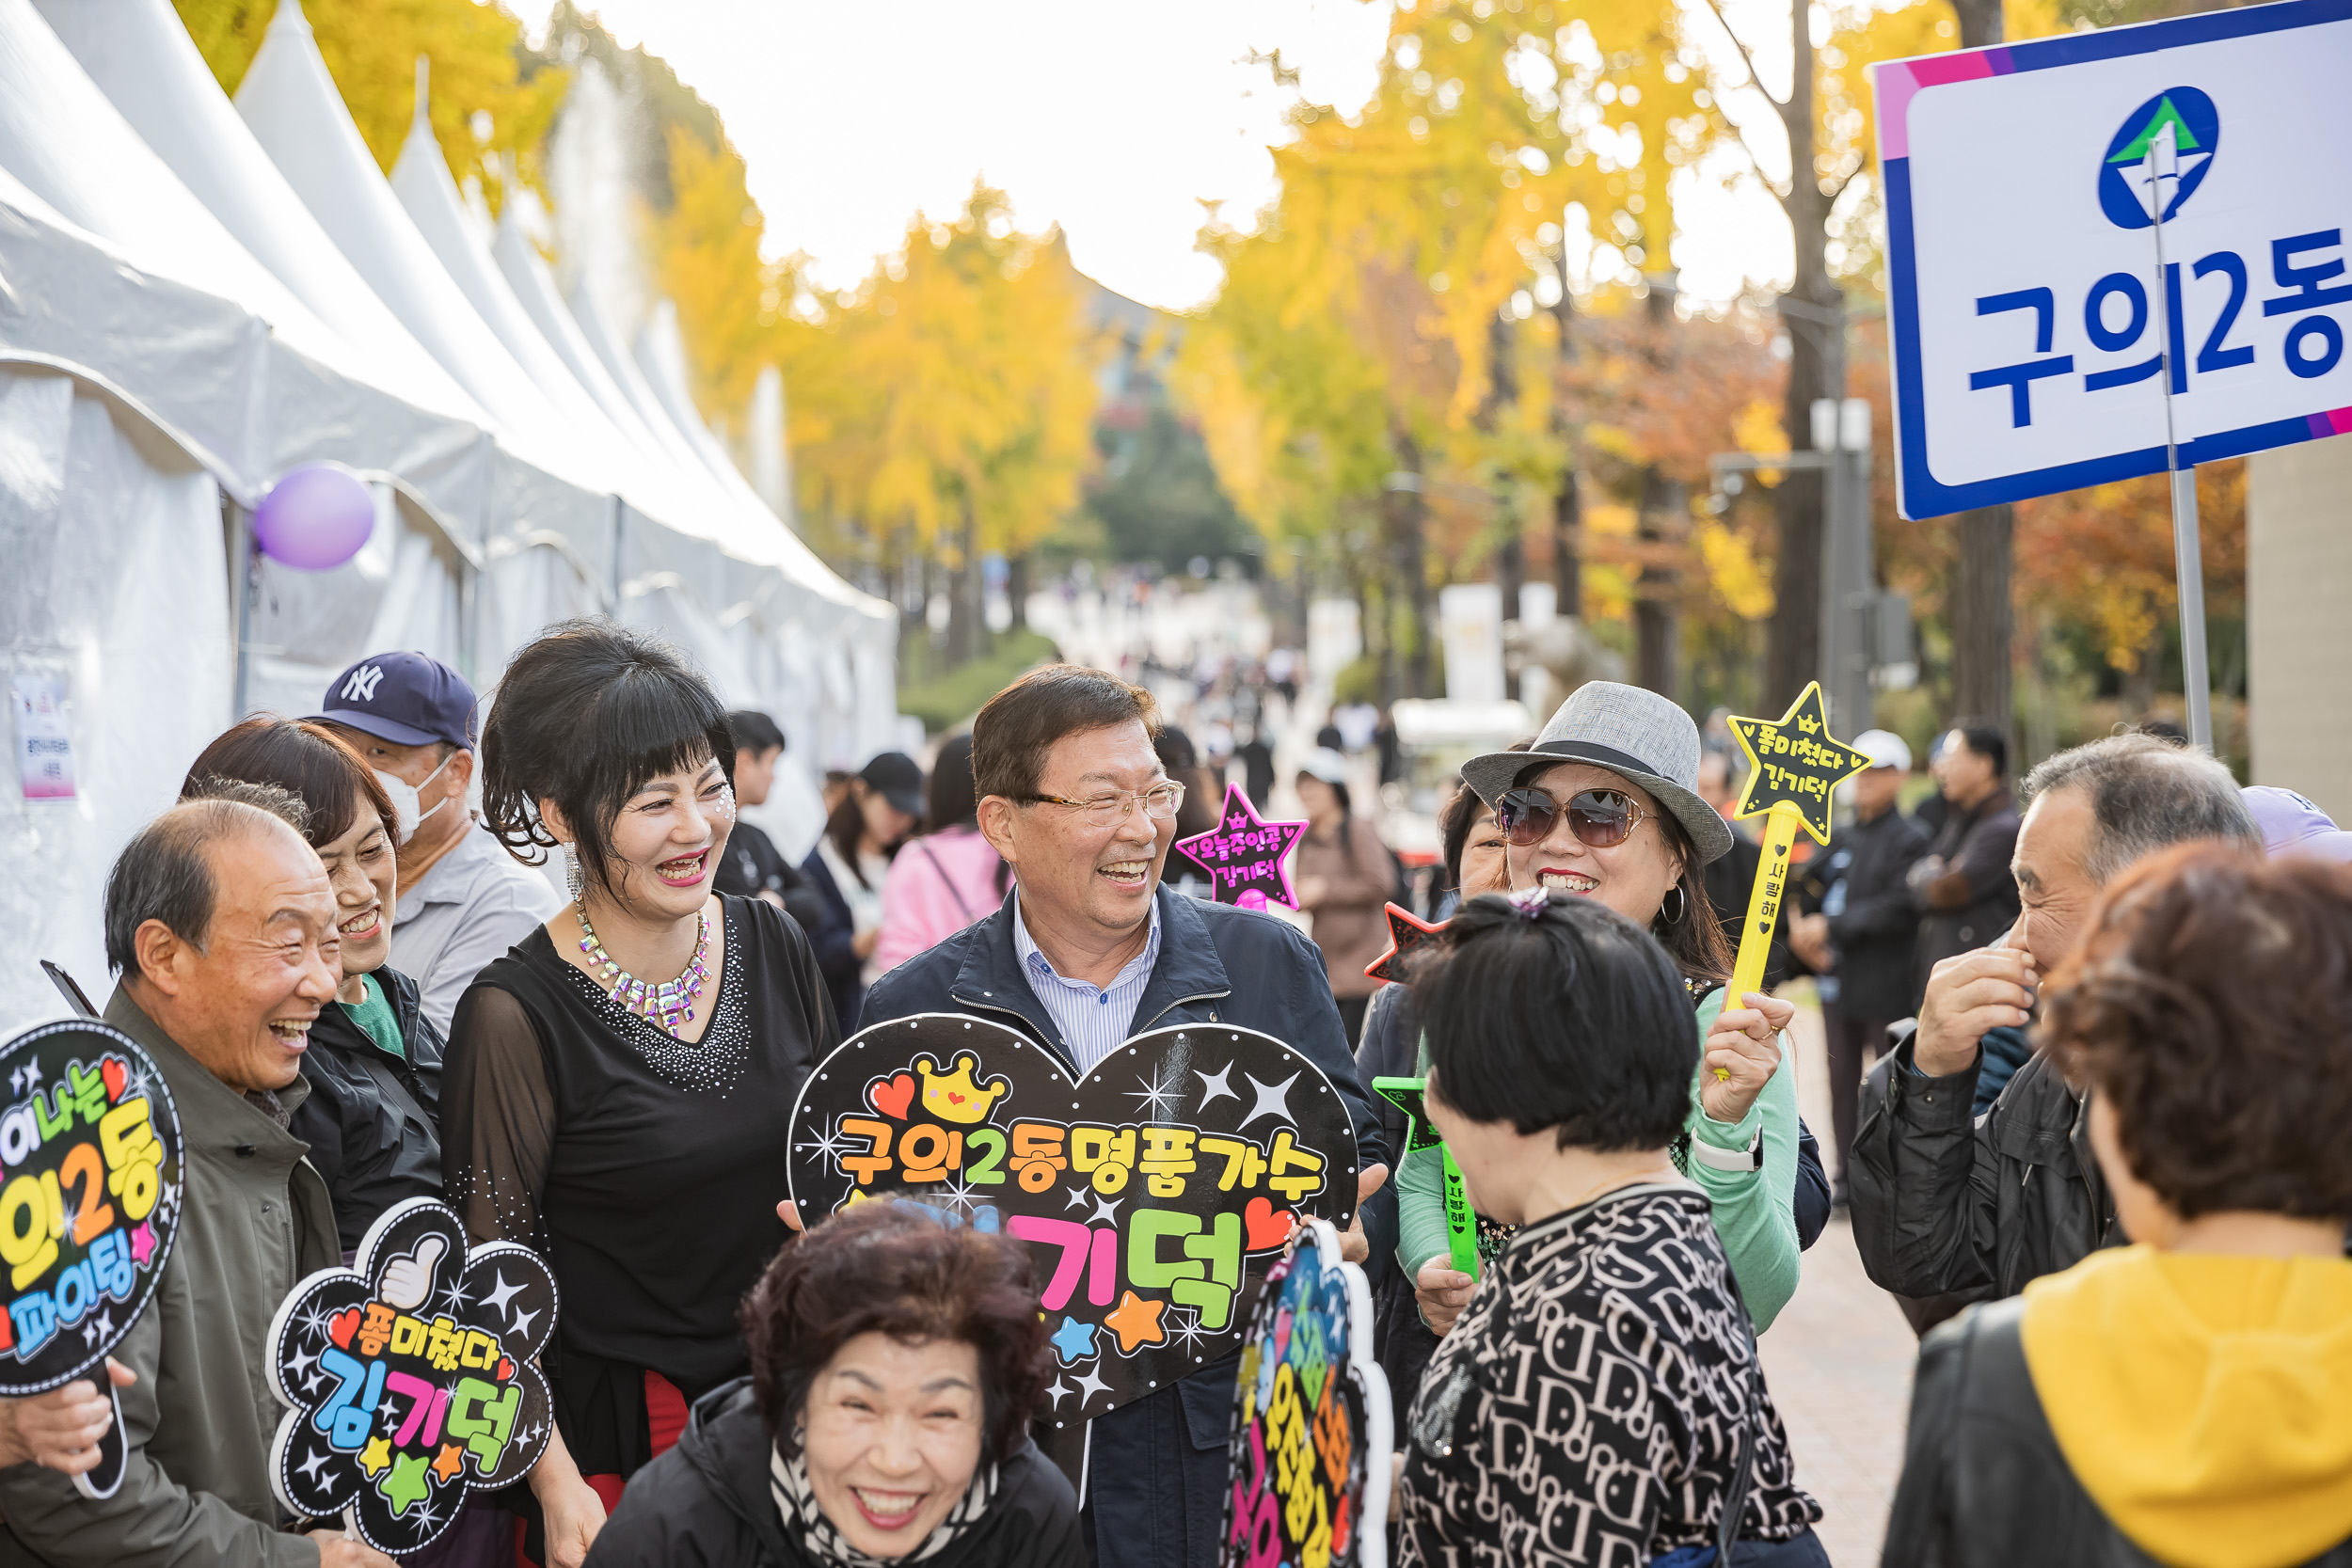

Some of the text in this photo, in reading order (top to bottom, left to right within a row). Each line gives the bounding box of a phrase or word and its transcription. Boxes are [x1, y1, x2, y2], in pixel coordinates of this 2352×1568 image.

[1967, 229, 2352, 429] 구의2동
[341, 664, 384, 702] NY
[1763, 763, 1828, 802] 김기덕
[1216, 859, 1276, 888] 김기덕
[1760, 863, 1785, 917] 사랑해
[9, 1227, 133, 1357] 파이팅
[890, 1198, 1241, 1328] 기덕
[315, 1348, 520, 1472] 김기덕
